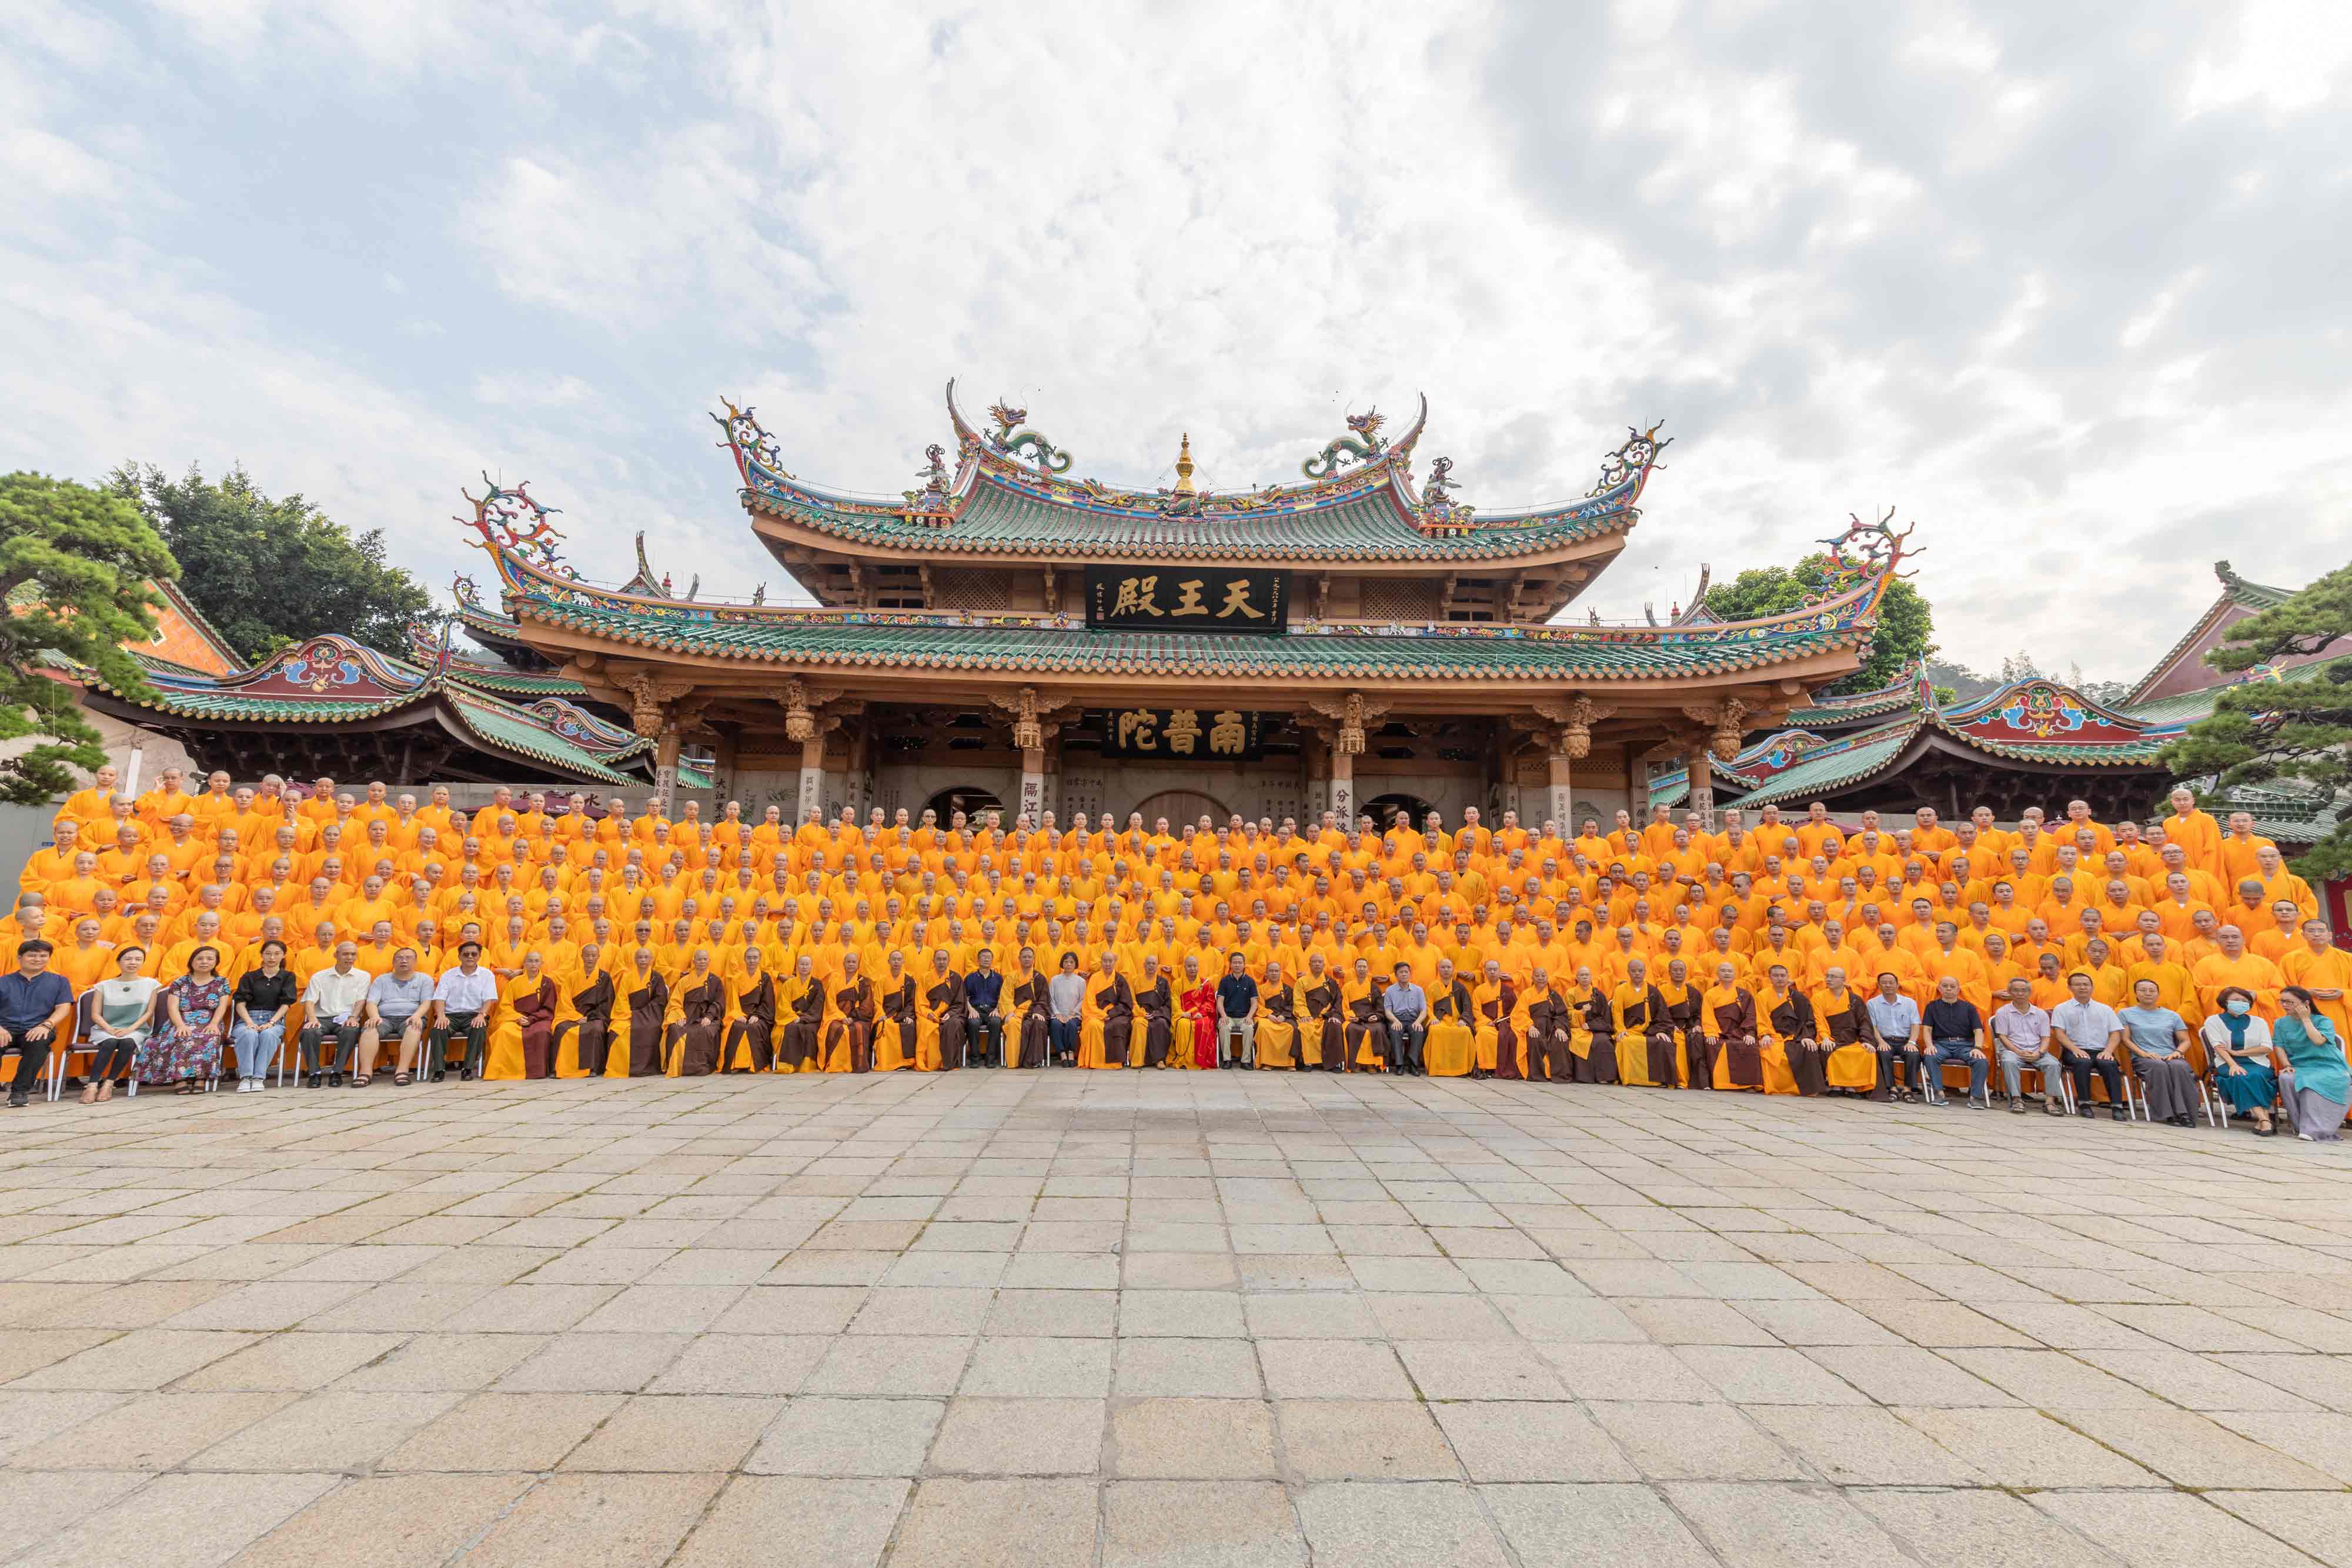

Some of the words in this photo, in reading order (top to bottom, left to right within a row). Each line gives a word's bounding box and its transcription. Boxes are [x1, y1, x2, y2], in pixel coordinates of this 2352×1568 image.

[1110, 575, 1265, 618] 天王殿
[1118, 707, 1245, 754] 南普陀
